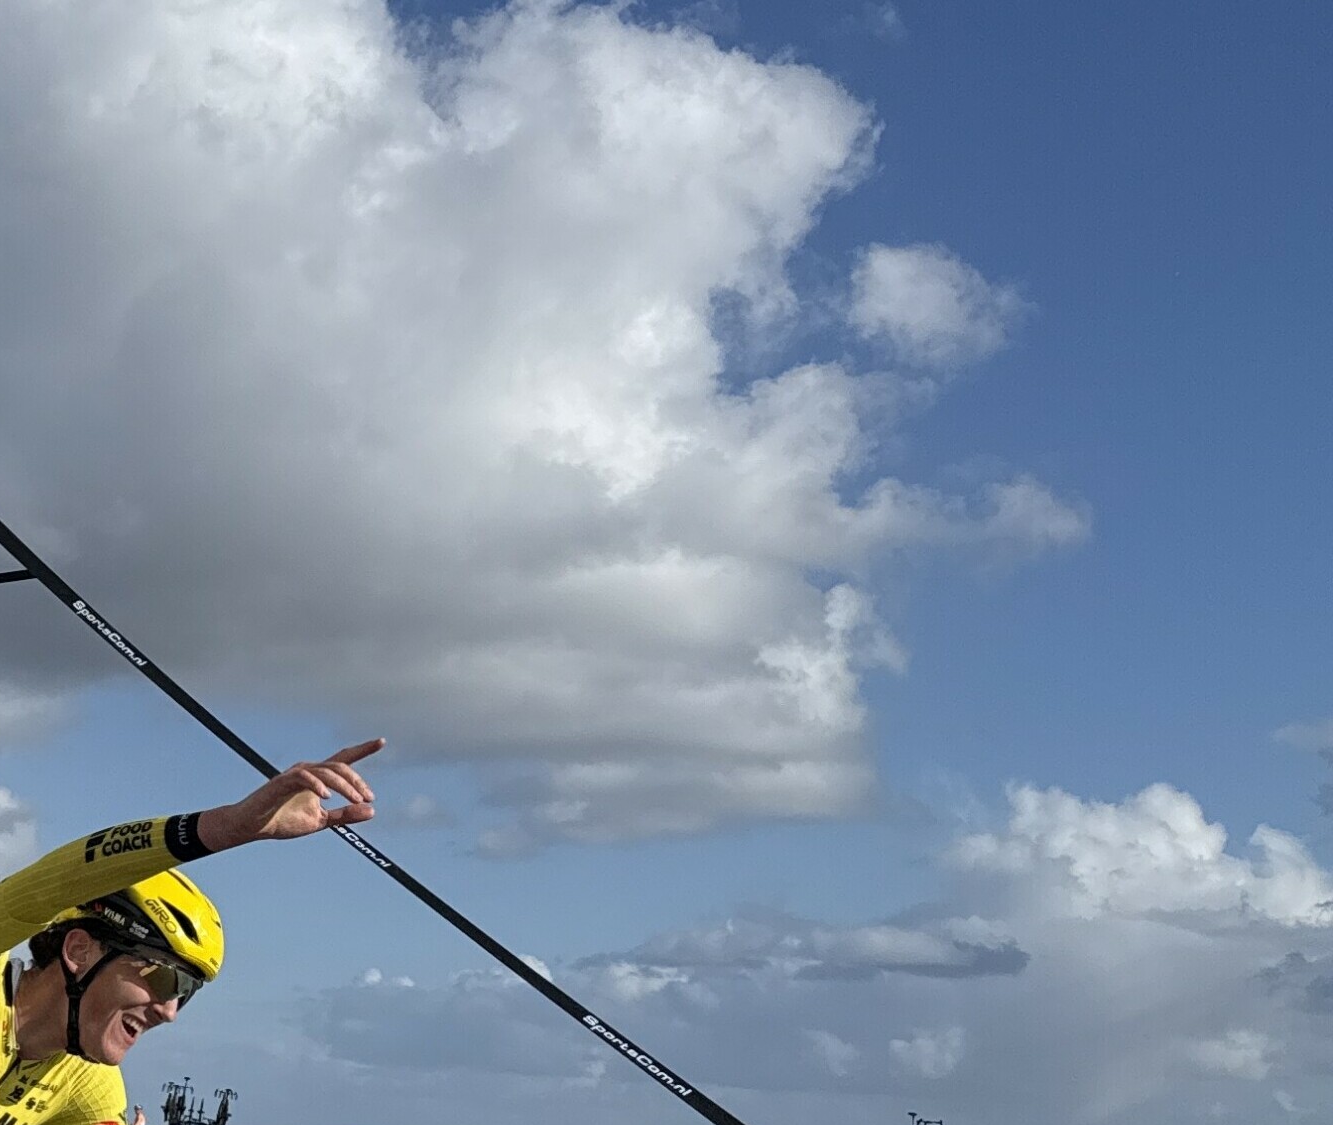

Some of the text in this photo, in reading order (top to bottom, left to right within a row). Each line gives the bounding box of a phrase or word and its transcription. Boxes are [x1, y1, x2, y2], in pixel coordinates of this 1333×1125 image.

[72, 599, 148, 667] SportsCom.nl
[102, 833, 152, 857] COACH
[111, 821, 153, 839] FOOD
[332, 825, 391, 868] sCom.nl
[144, 898, 178, 934] GIRO
[582, 1014, 692, 1098] SportsCom.nl
